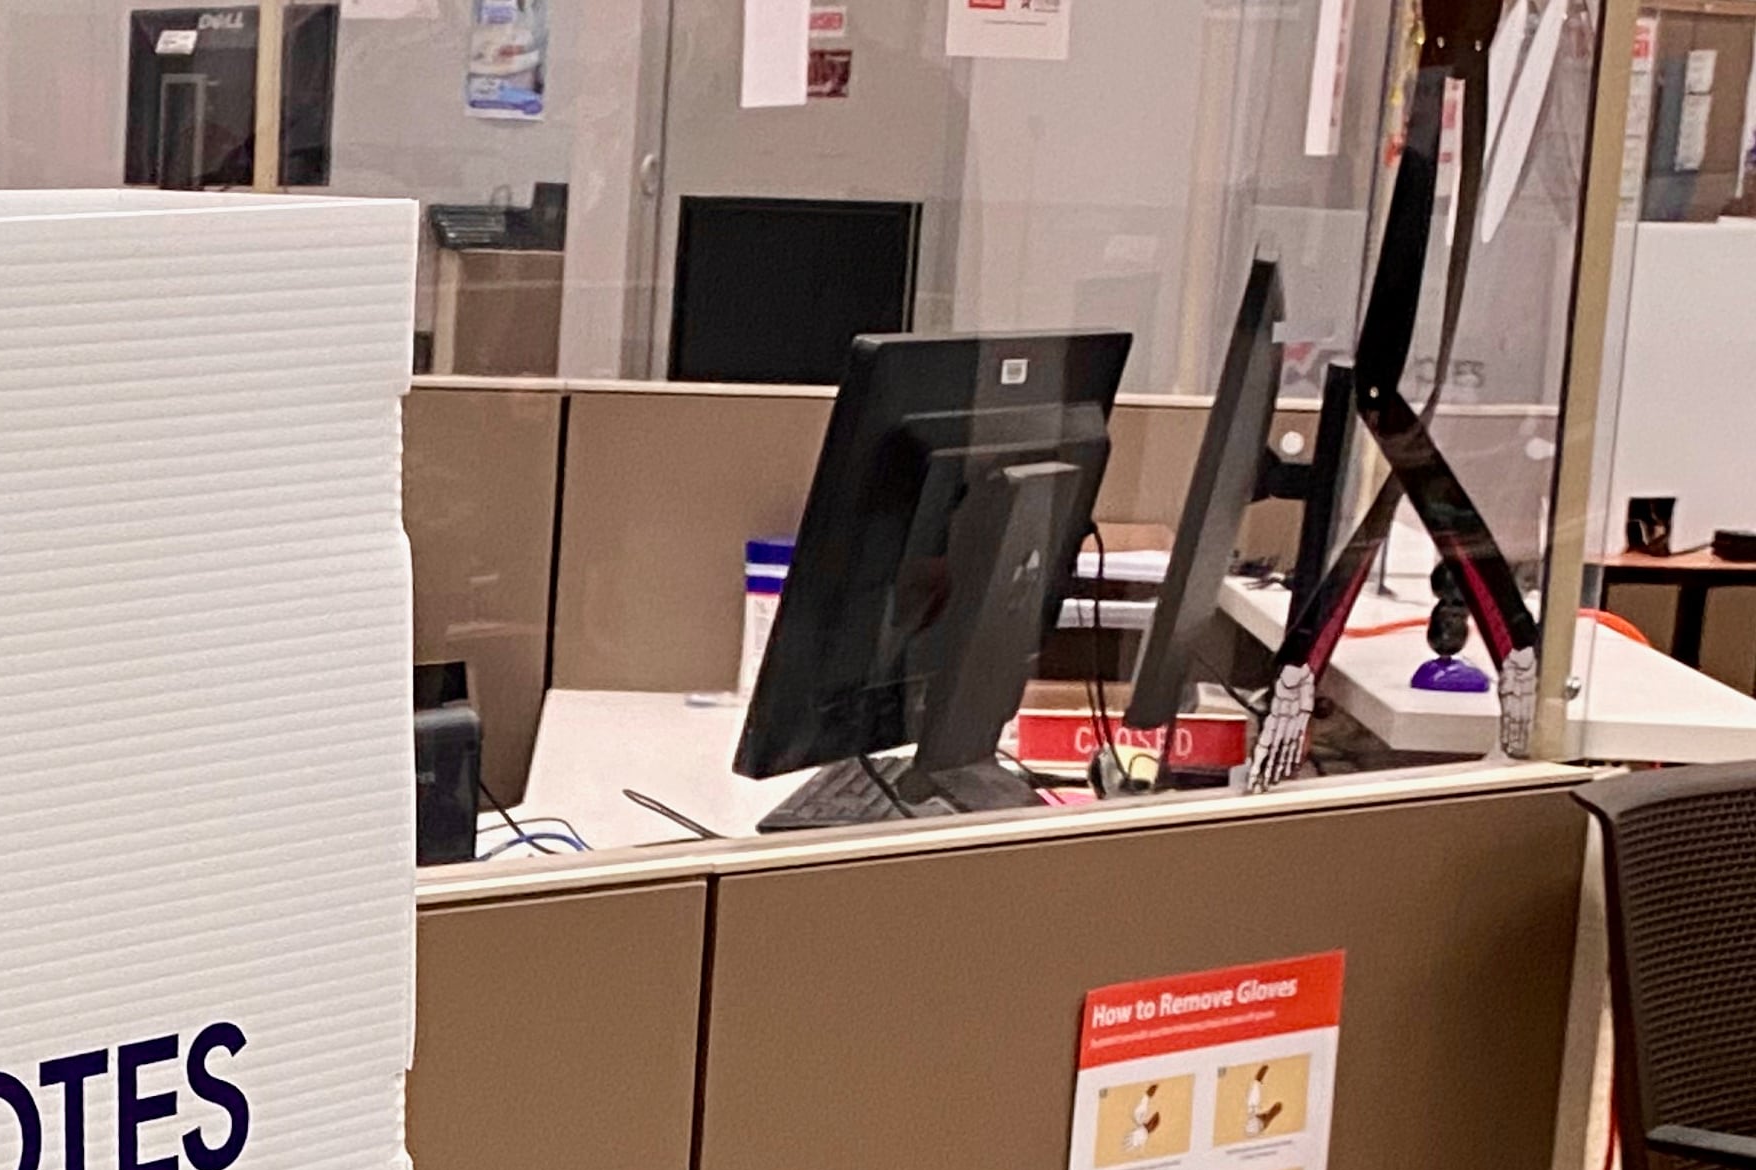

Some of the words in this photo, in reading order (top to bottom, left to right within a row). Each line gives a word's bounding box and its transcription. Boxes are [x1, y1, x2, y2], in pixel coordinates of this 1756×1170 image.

[198, 11, 243, 29] DELL
[1092, 1004, 1132, 1028] How
[1136, 1000, 1156, 1019] to
[1159, 989, 1234, 1017] Remove
[1236, 978, 1298, 1004] Gloves
